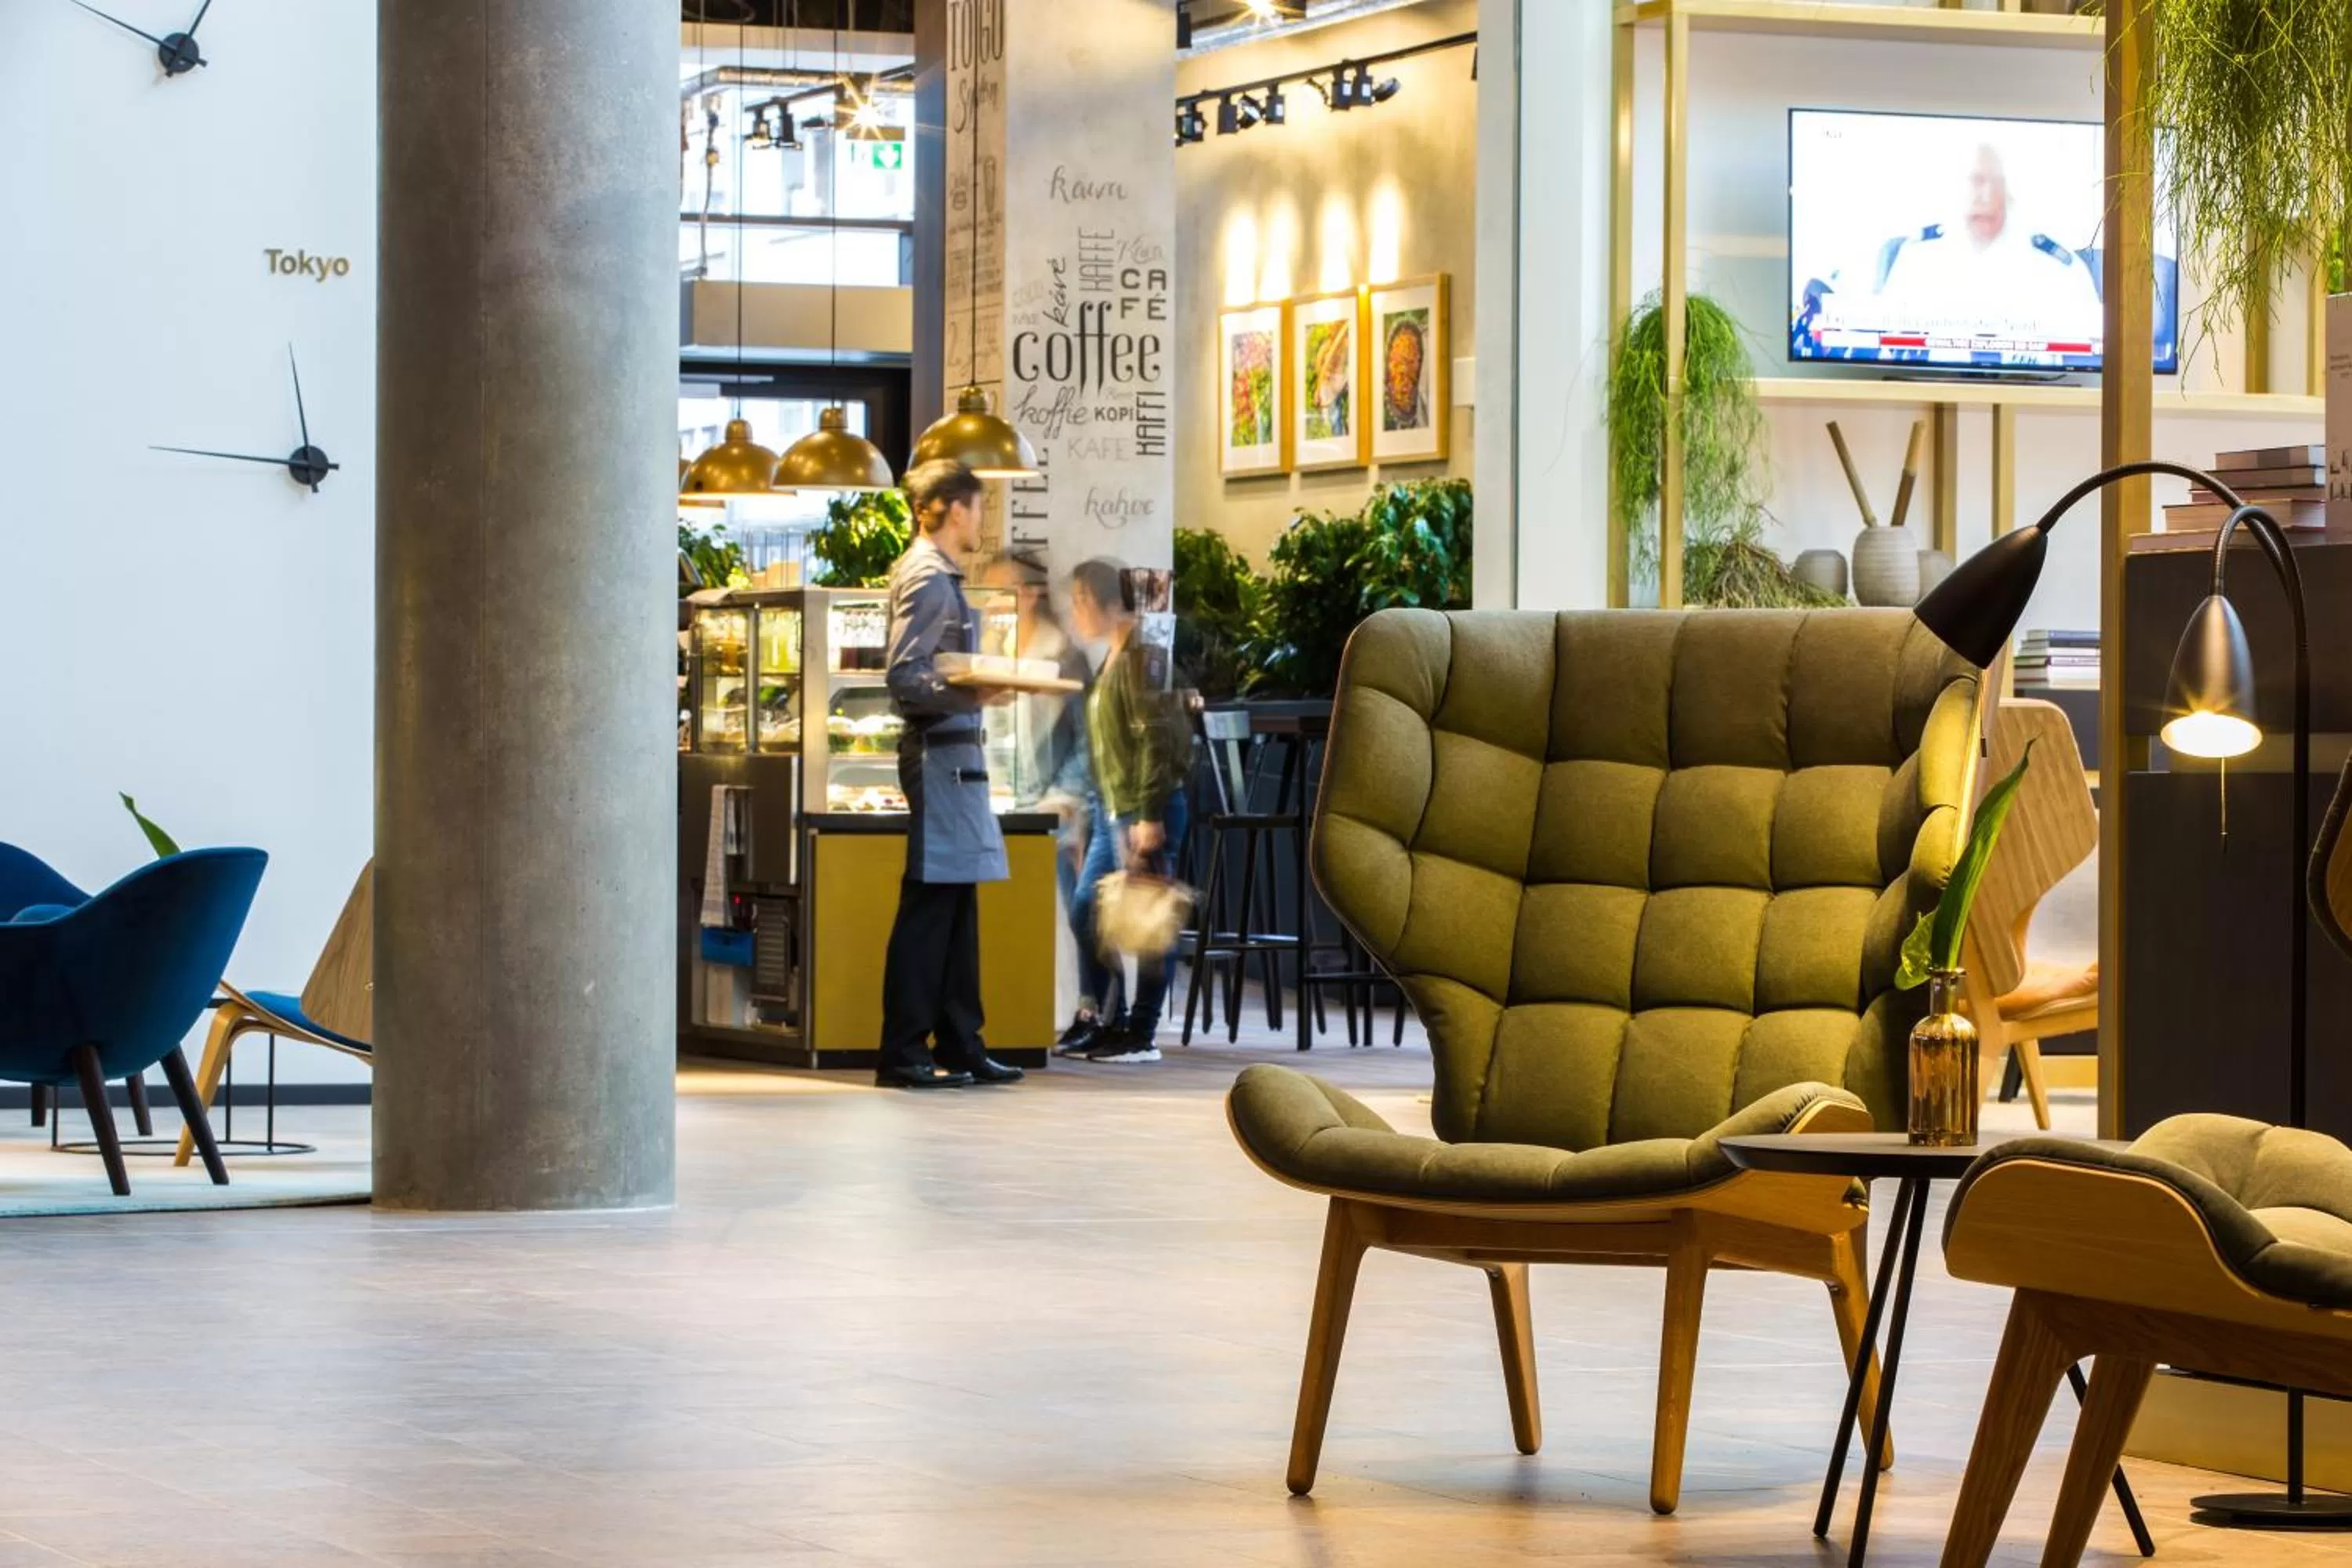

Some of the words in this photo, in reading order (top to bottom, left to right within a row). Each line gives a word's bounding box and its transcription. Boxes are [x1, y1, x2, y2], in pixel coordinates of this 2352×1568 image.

[264, 249, 350, 283] Tokyo
[1012, 299, 1161, 398] coffee
[1014, 383, 1091, 440] koffie
[1094, 405, 1134, 422] KOPI
